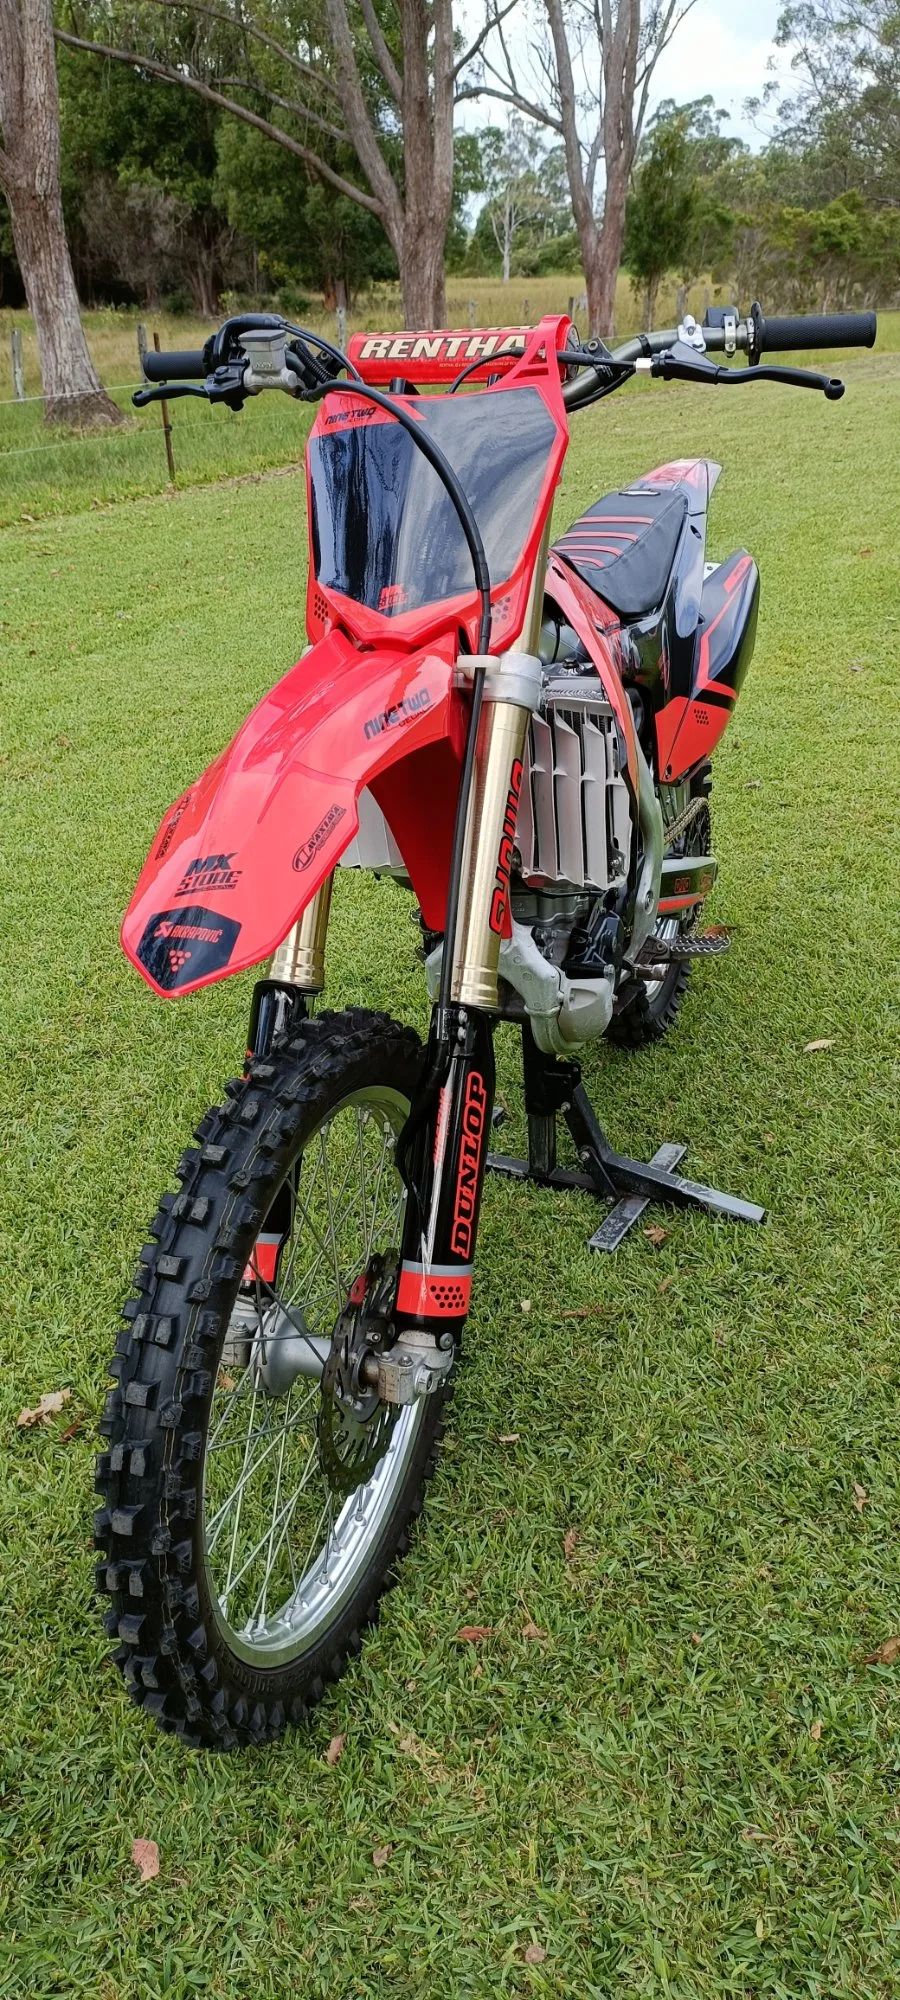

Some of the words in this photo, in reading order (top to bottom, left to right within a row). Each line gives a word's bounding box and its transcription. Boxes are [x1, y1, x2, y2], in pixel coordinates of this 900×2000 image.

[359, 334, 546, 359] RENTHA
[184, 852, 239, 877] MX
[177, 870, 243, 892] STORE
[451, 1071, 487, 1260] DUNLOP
